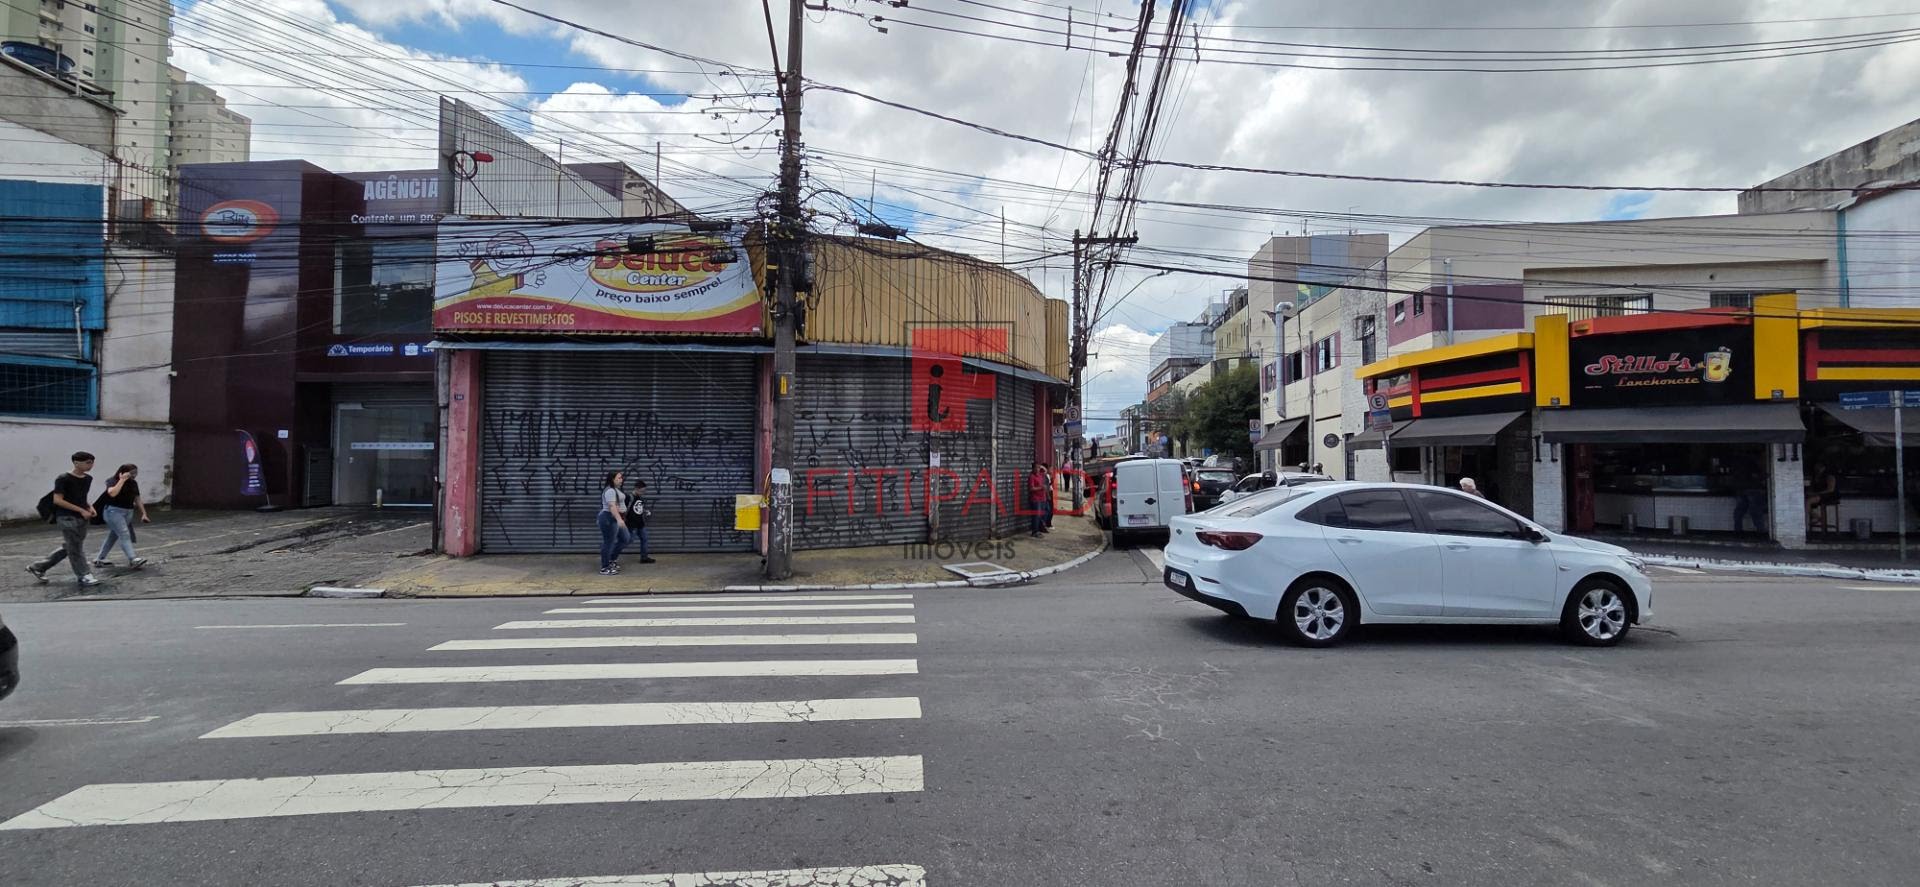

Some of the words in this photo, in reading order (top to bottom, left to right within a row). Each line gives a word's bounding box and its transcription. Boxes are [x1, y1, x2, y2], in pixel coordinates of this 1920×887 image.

[363, 174, 439, 201] AGÊNCIA
[350, 213, 395, 224] Contrate
[400, 213, 416, 223] um
[626, 271, 688, 287] Center
[595, 288, 632, 304] preço
[635, 294, 671, 304] baixo
[673, 276, 723, 301] sempre!
[454, 312, 483, 324] PISOS
[485, 312, 492, 324] E
[494, 312, 576, 325] REVESTIMENTOS
[348, 344, 394, 354] Temporários
